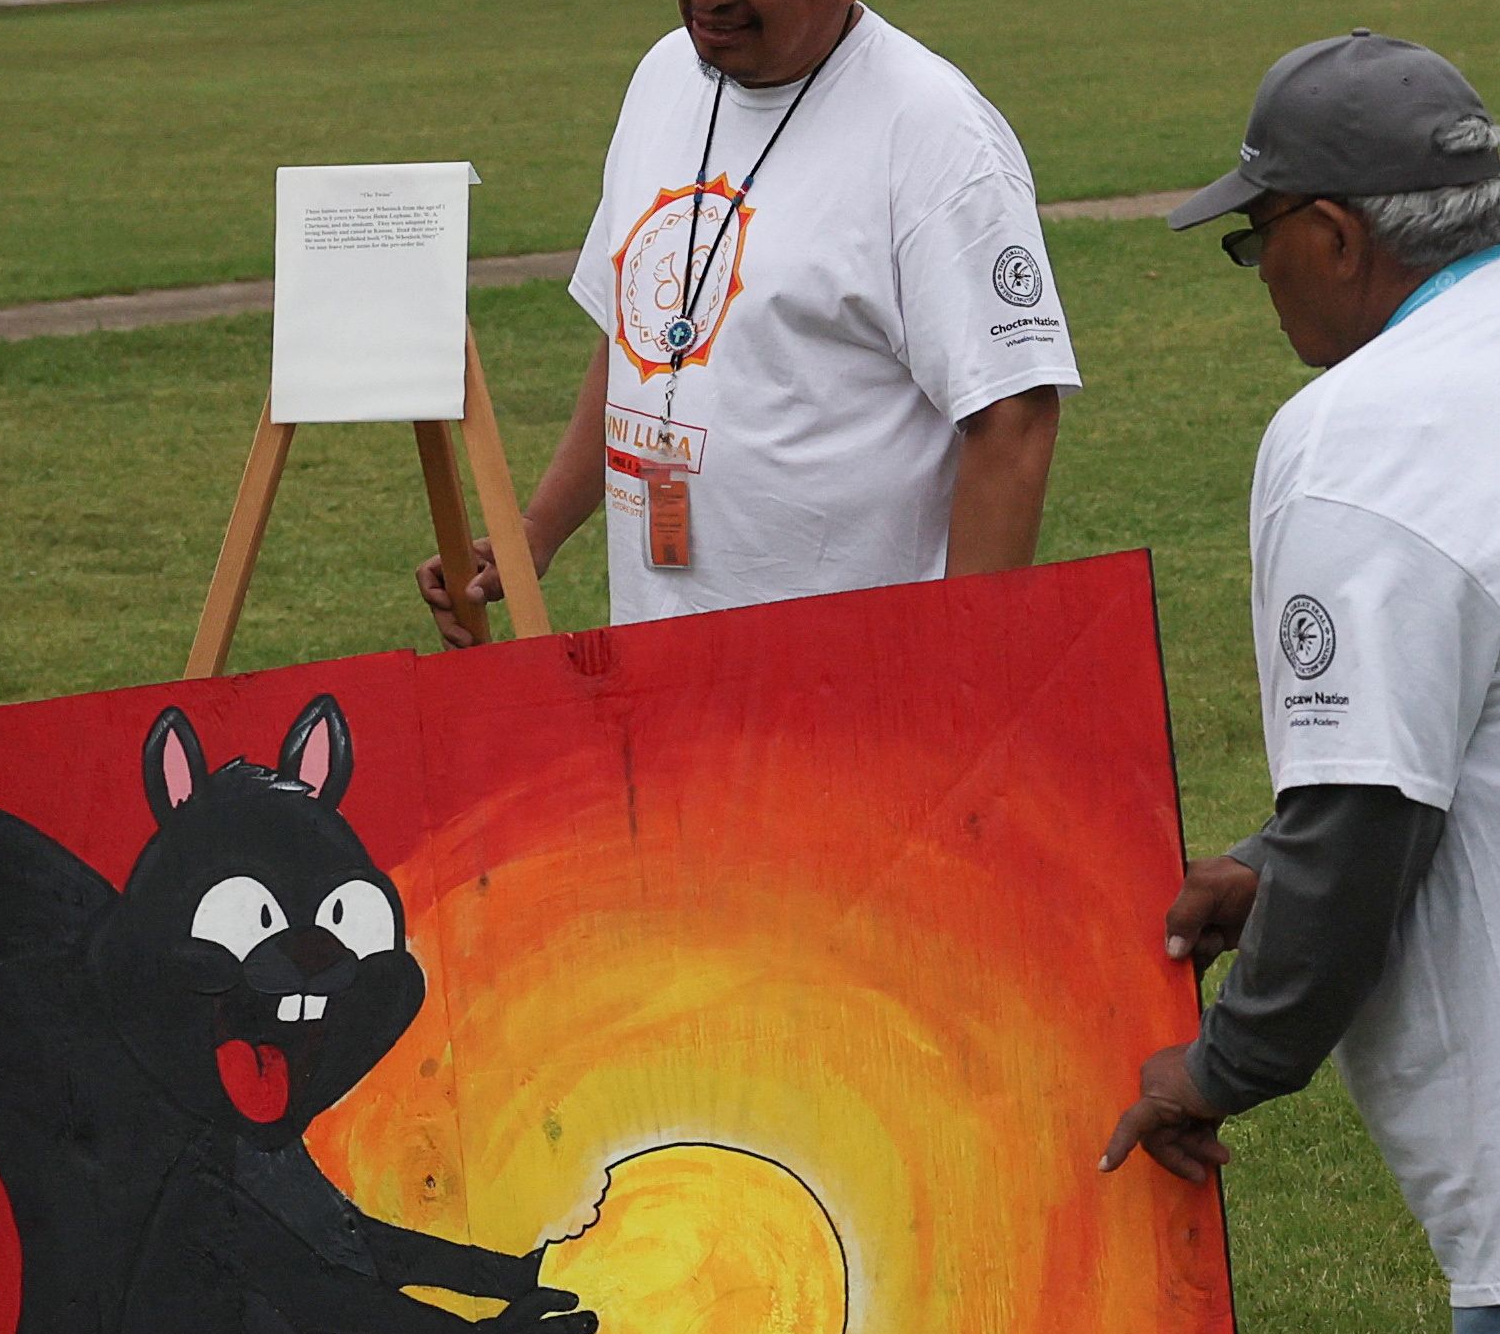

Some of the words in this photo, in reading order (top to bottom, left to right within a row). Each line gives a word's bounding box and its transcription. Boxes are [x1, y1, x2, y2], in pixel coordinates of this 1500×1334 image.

[990, 318, 1033, 336] Choctaw
[1033, 316, 1060, 327] Nation
[1314, 692, 1349, 705] Nation
